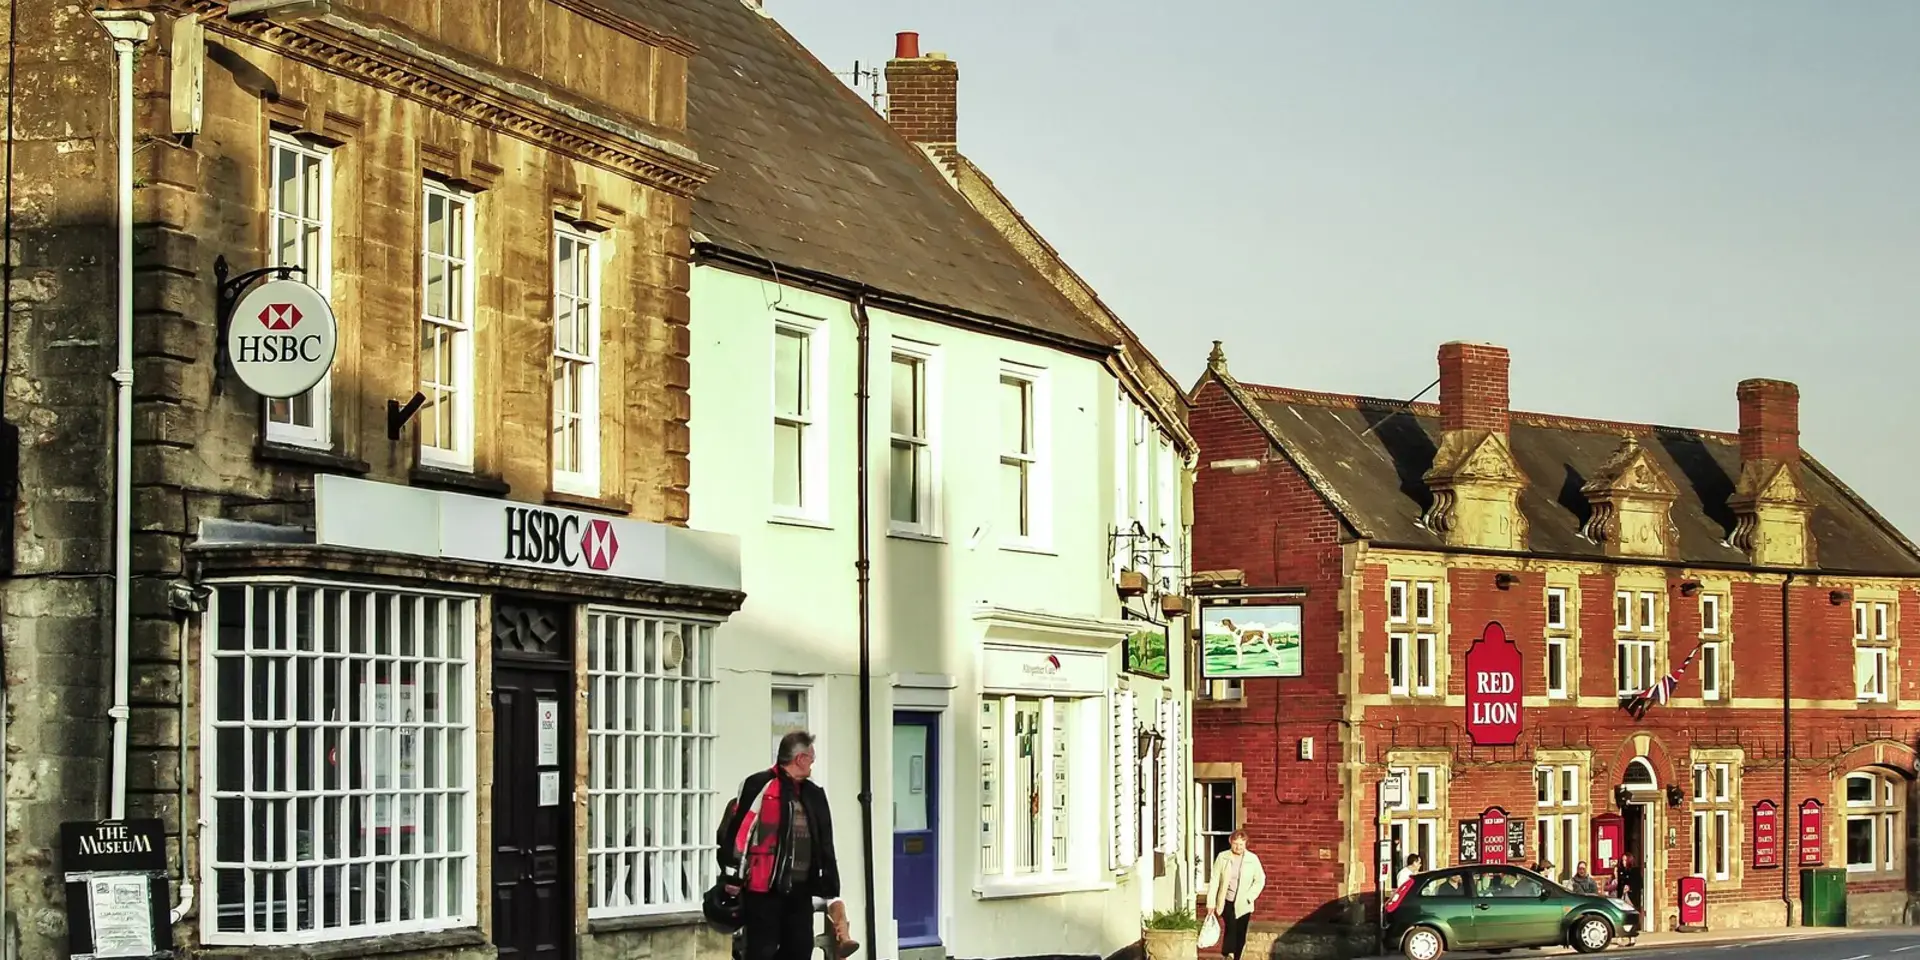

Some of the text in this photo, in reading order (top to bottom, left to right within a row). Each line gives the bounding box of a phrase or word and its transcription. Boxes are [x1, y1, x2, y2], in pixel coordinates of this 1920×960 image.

[237, 335, 322, 363] HSBC
[504, 506, 580, 567] HSBC
[1477, 671, 1515, 694] RED
[1472, 702, 1518, 725] LION
[95, 826, 129, 840] THE
